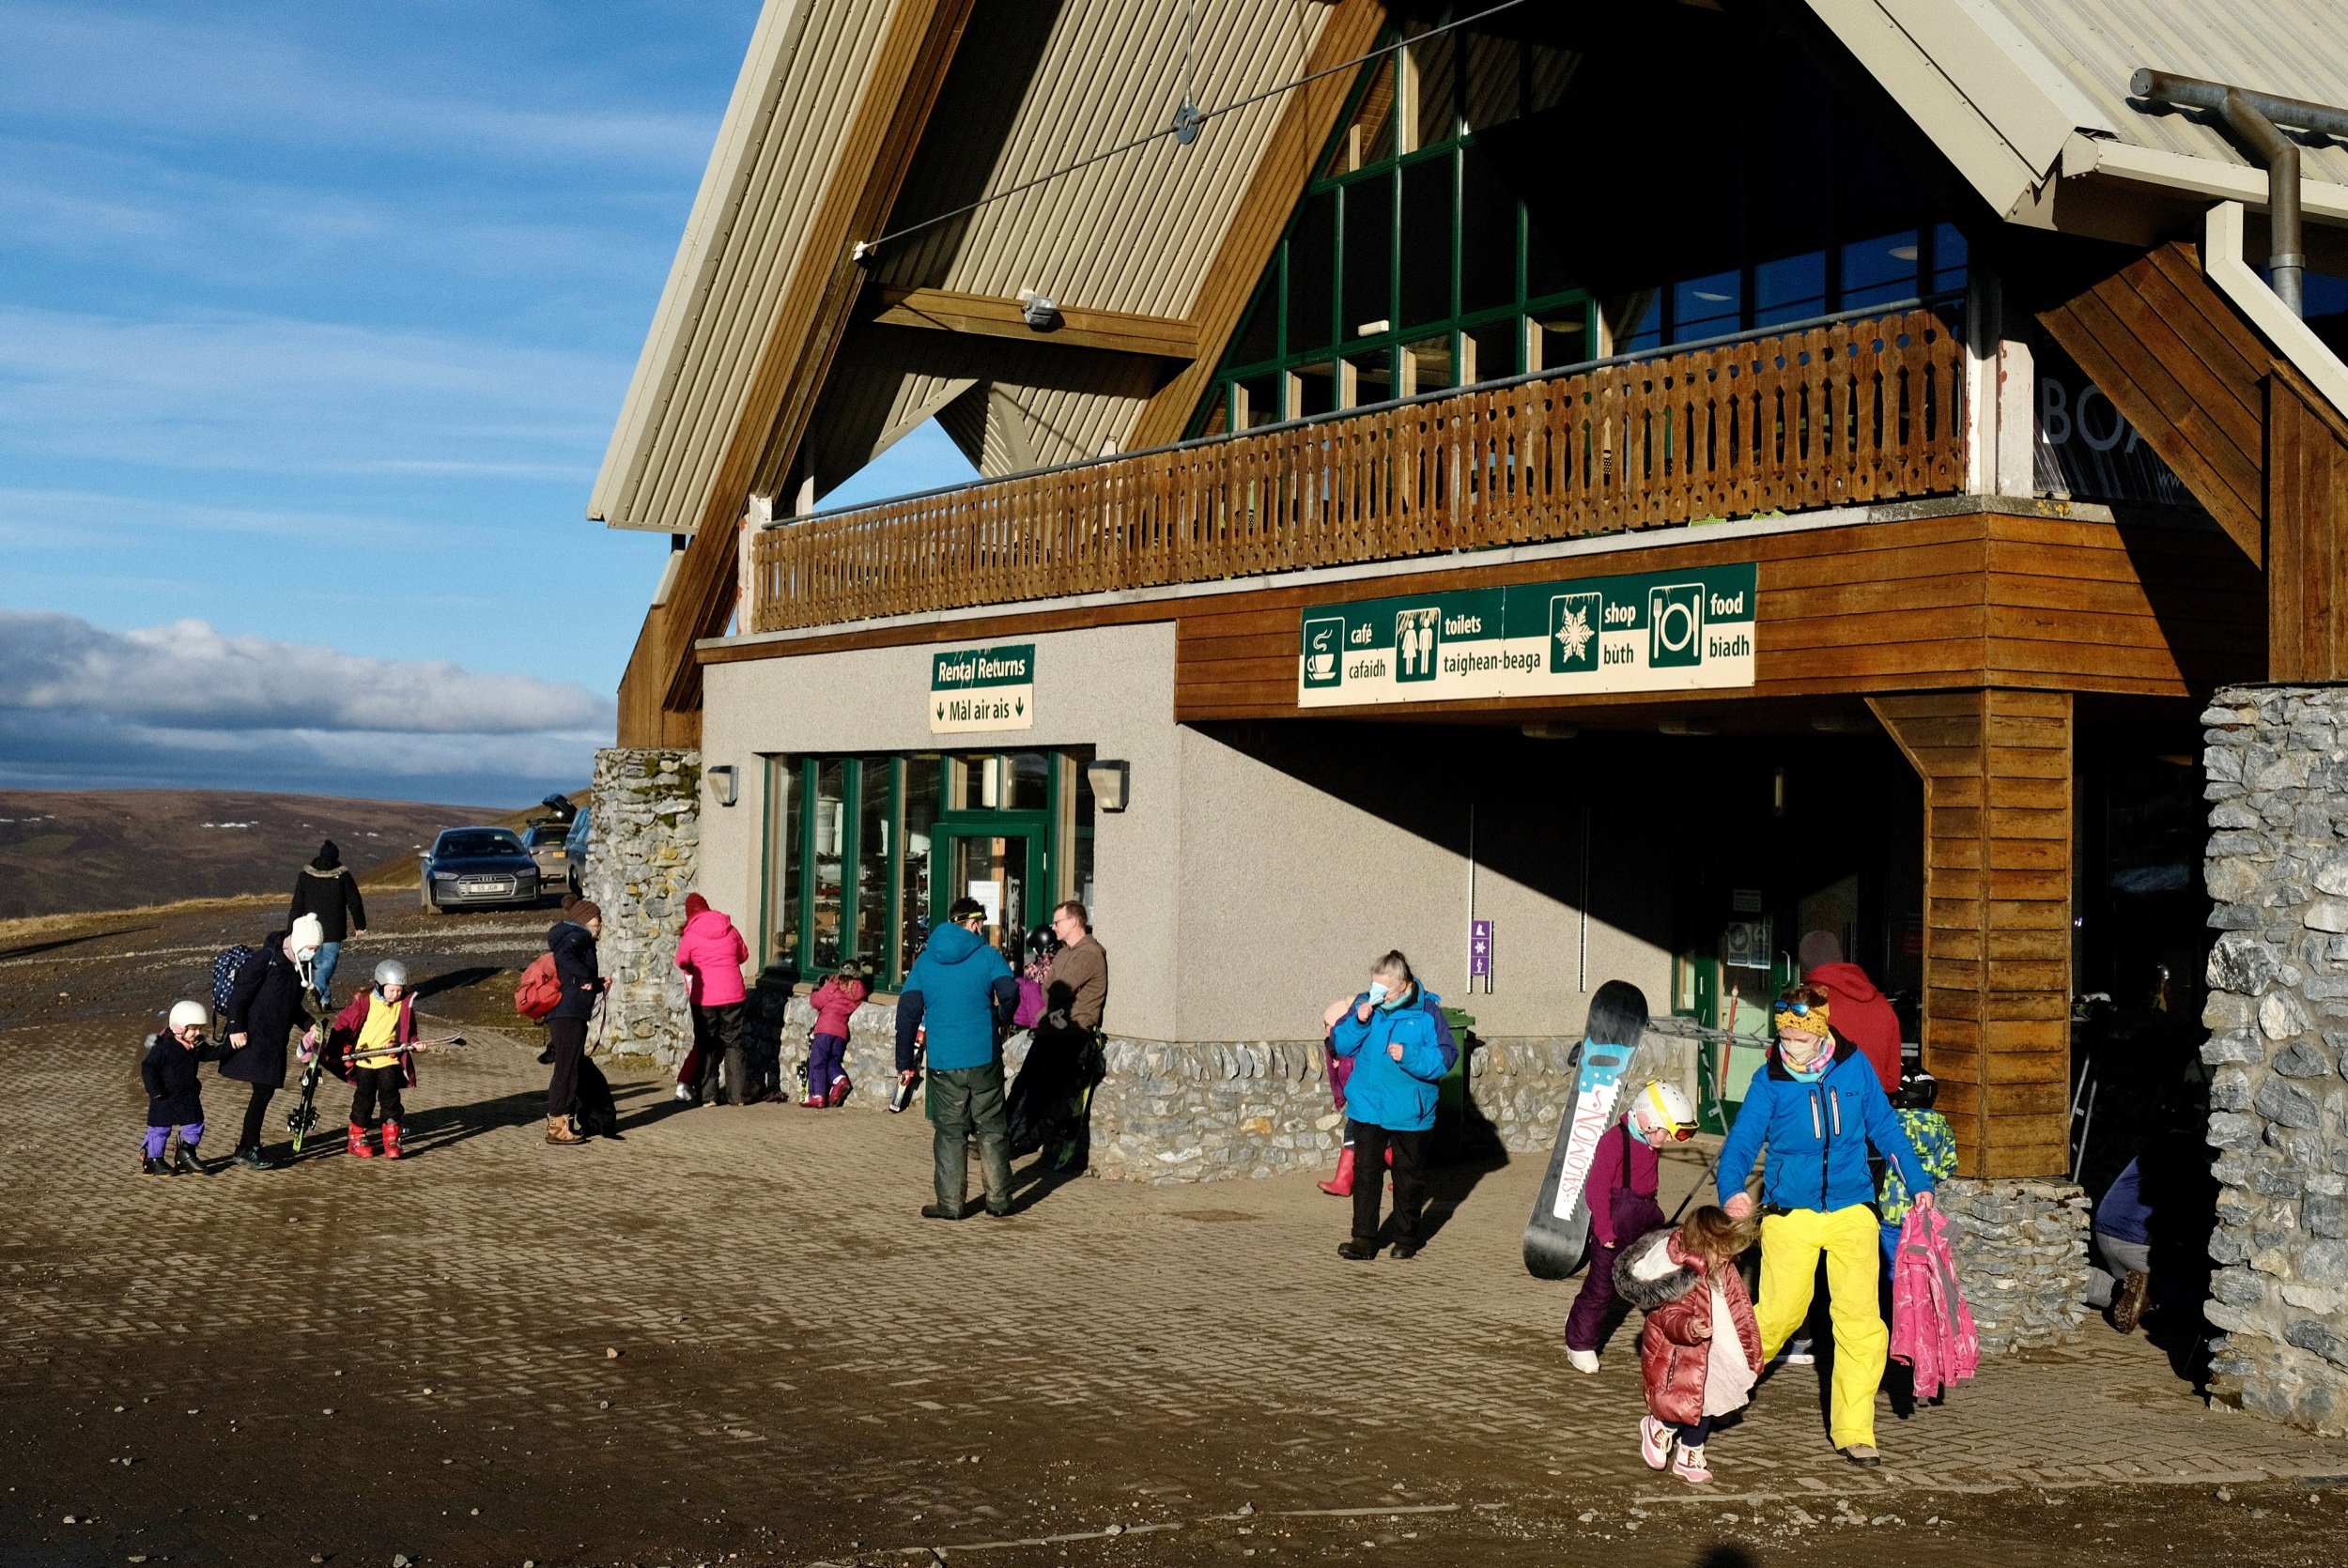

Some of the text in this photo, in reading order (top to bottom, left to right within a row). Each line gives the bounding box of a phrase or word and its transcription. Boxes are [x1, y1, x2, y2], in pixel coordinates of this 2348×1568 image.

[1604, 601, 1636, 627] shop
[1710, 591, 1744, 616] food
[1351, 623, 1372, 645] café
[1444, 614, 1482, 636] toilets
[1603, 643, 1634, 665] bùth
[1709, 635, 1750, 658] biadh
[938, 656, 1026, 682] Rental Returns
[1349, 658, 1386, 679] cafaidh
[1444, 651, 1541, 676] taighean-beaga
[950, 698, 1010, 721] Màl air ais
[1562, 1106, 1607, 1195] SALOMON
